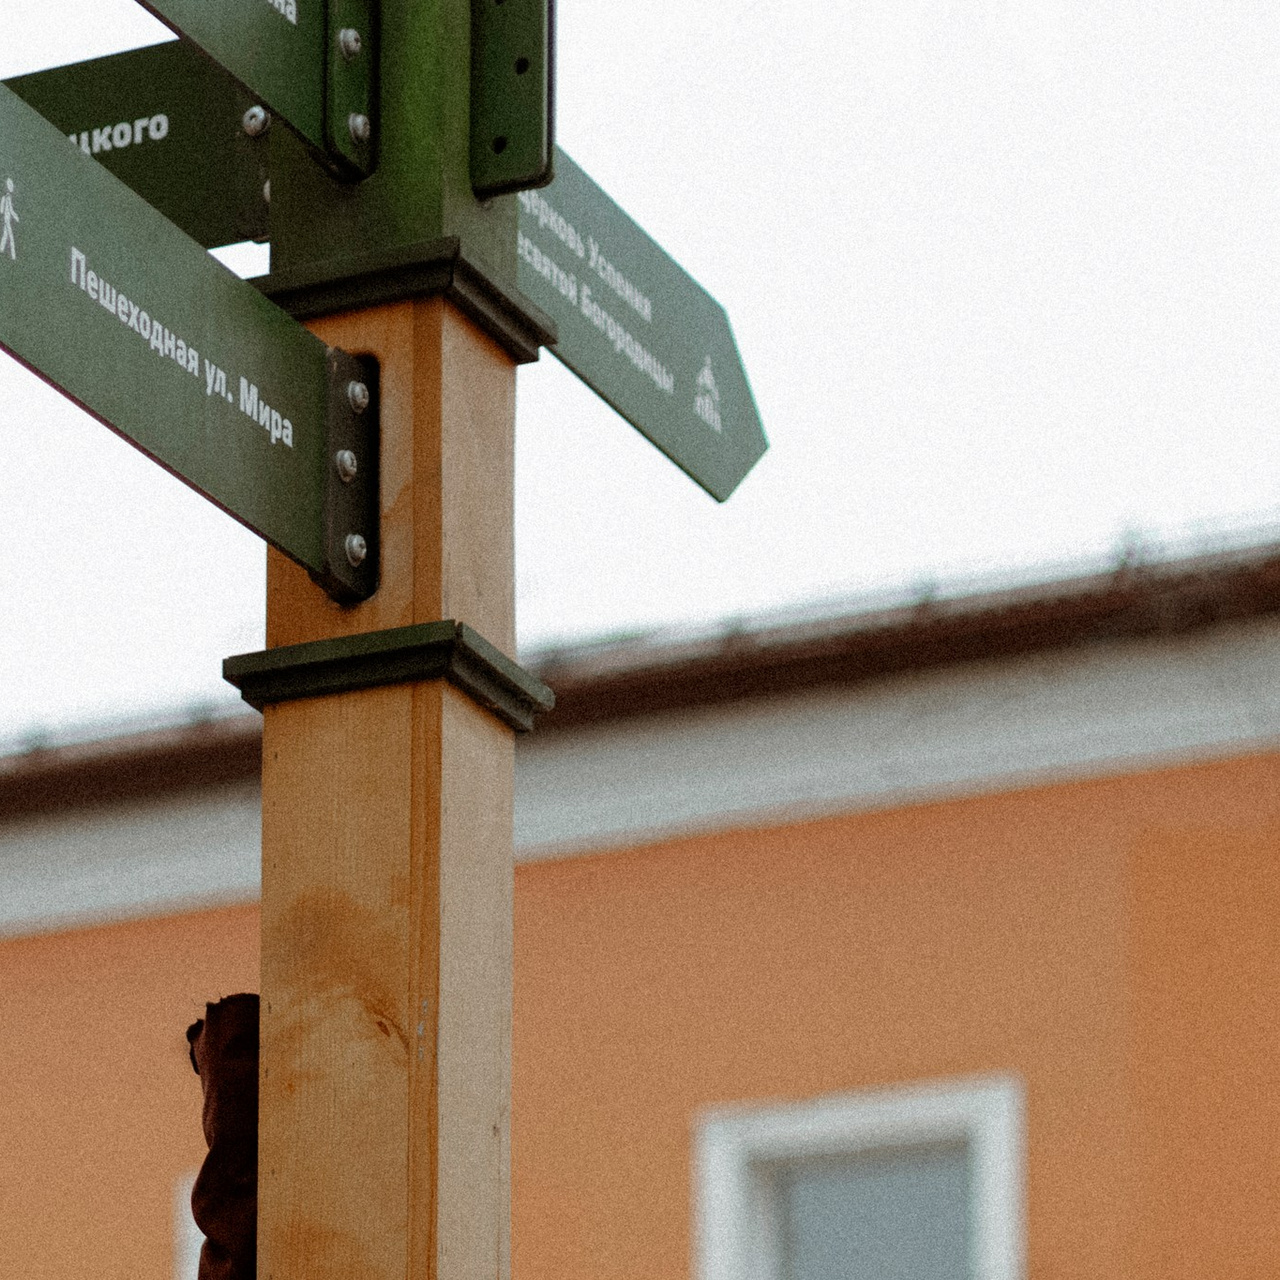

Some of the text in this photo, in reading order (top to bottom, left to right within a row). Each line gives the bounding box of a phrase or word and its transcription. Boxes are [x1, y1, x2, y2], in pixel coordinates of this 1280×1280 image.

[69, 113, 169, 156] цкого
[517, 231, 578, 306] есвятой
[70, 246, 294, 448] Пешеходная ул. Мира
